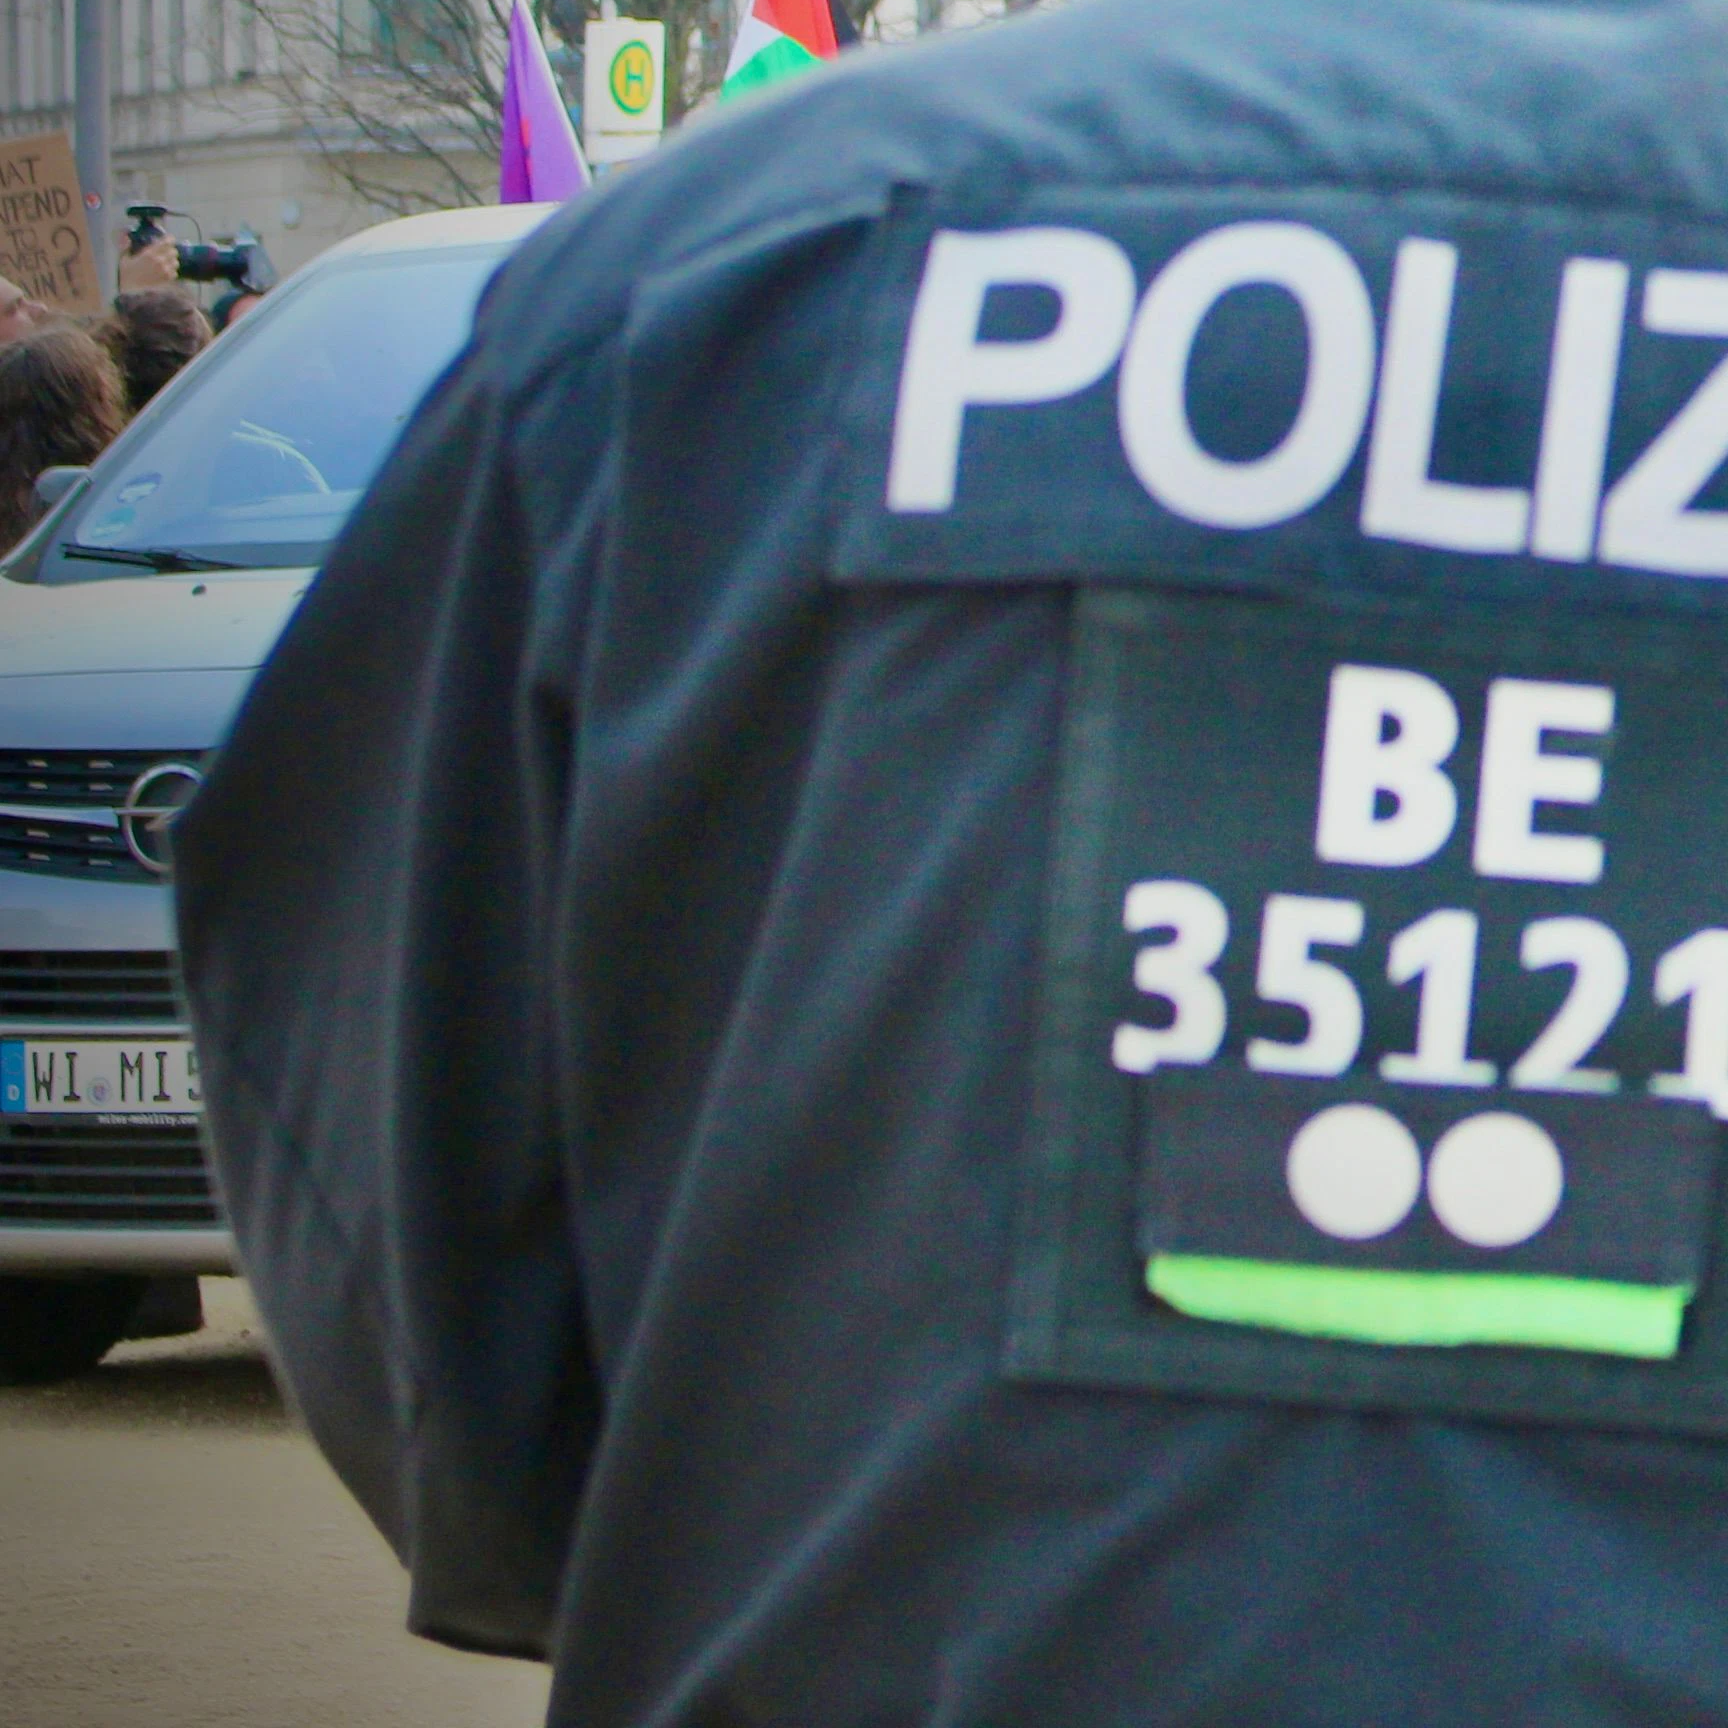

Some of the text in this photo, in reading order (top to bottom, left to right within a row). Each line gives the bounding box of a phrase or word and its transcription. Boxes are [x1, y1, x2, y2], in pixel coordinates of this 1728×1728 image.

[1315, 664, 1615, 884] BE
[32, 1051, 81, 1102] WI
[119, 1051, 171, 1102] MI
